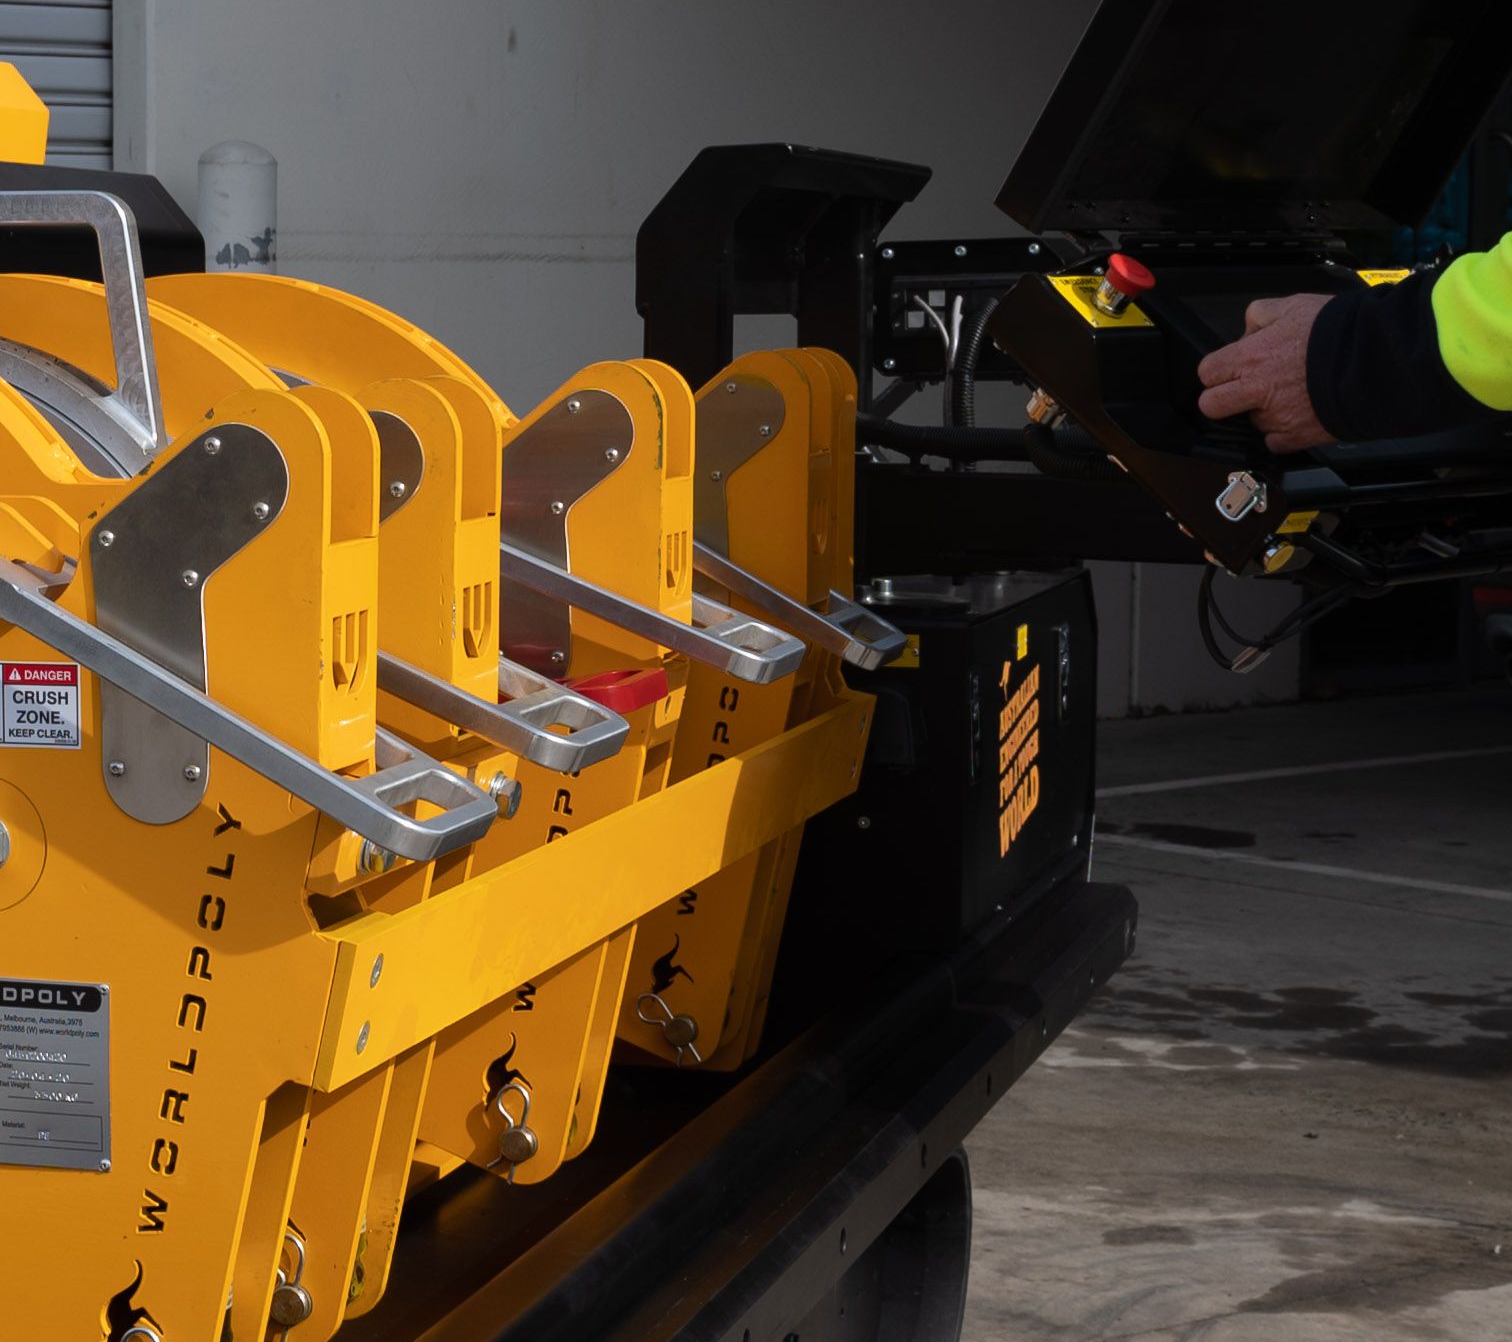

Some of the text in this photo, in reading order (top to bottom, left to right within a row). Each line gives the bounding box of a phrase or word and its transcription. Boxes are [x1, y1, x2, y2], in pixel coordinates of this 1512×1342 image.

[24, 669, 72, 681] DANGER
[12, 690, 69, 705] CRUSH
[16, 710, 65, 725] ZONE.
[8, 728, 73, 739] KEEP CLEAR.
[999, 764, 1040, 858] WORLD
[136, 802, 242, 1235] WORLDPOLY
[39, 1028, 100, 1038] www.worldpoly.com
